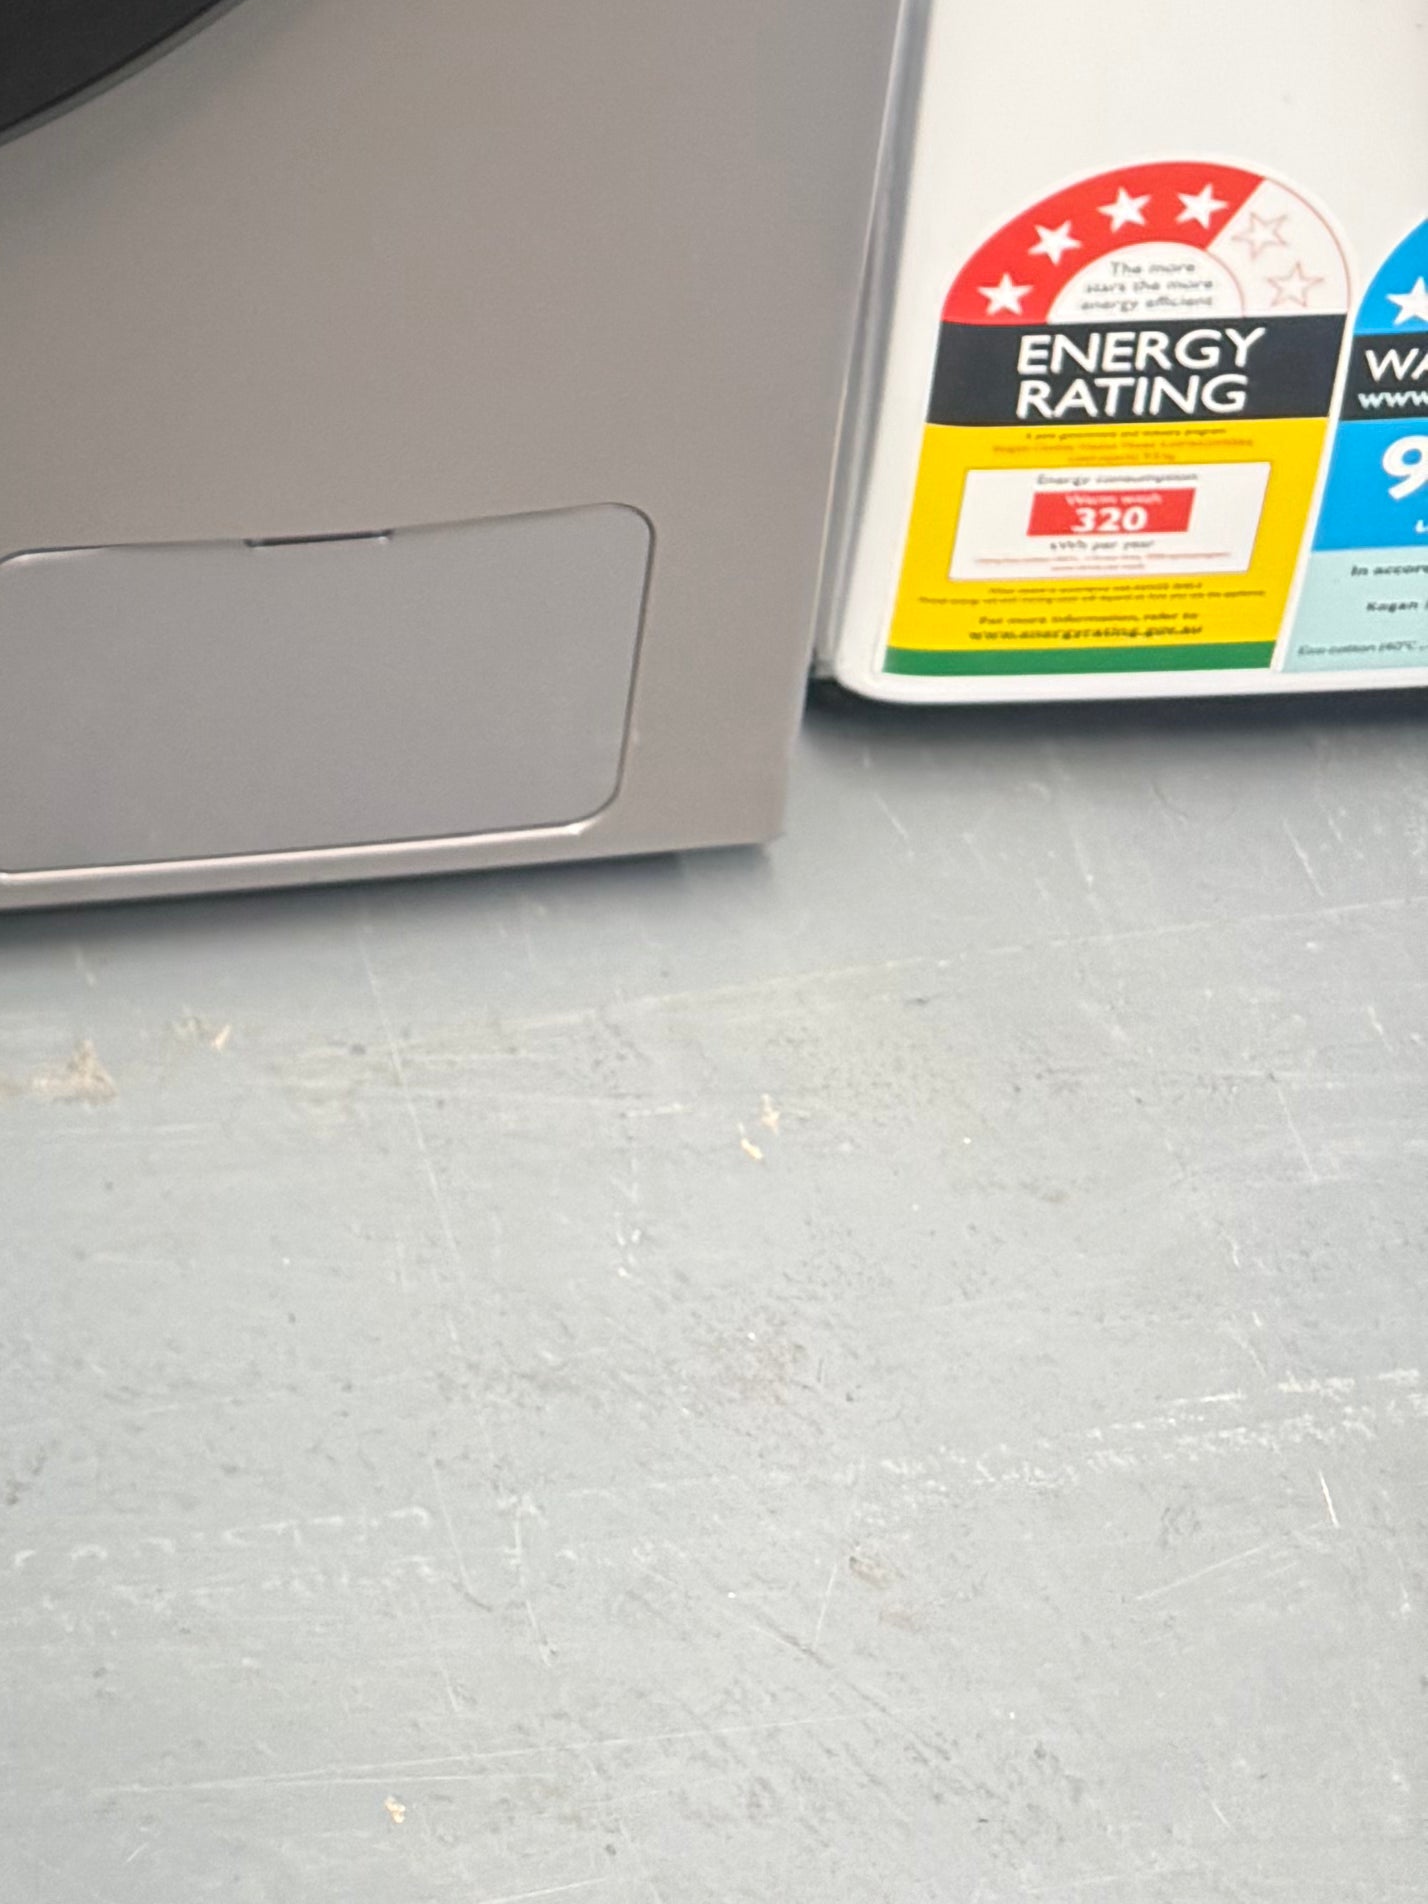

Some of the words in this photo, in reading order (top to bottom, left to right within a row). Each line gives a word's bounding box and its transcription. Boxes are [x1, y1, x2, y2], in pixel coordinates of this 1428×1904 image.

[1111, 262, 1142, 275] The
[1149, 263, 1196, 274] more
[1017, 327, 1266, 375] ENERGY
[1015, 373, 1249, 421] RATING
[1071, 507, 1147, 533] 320
